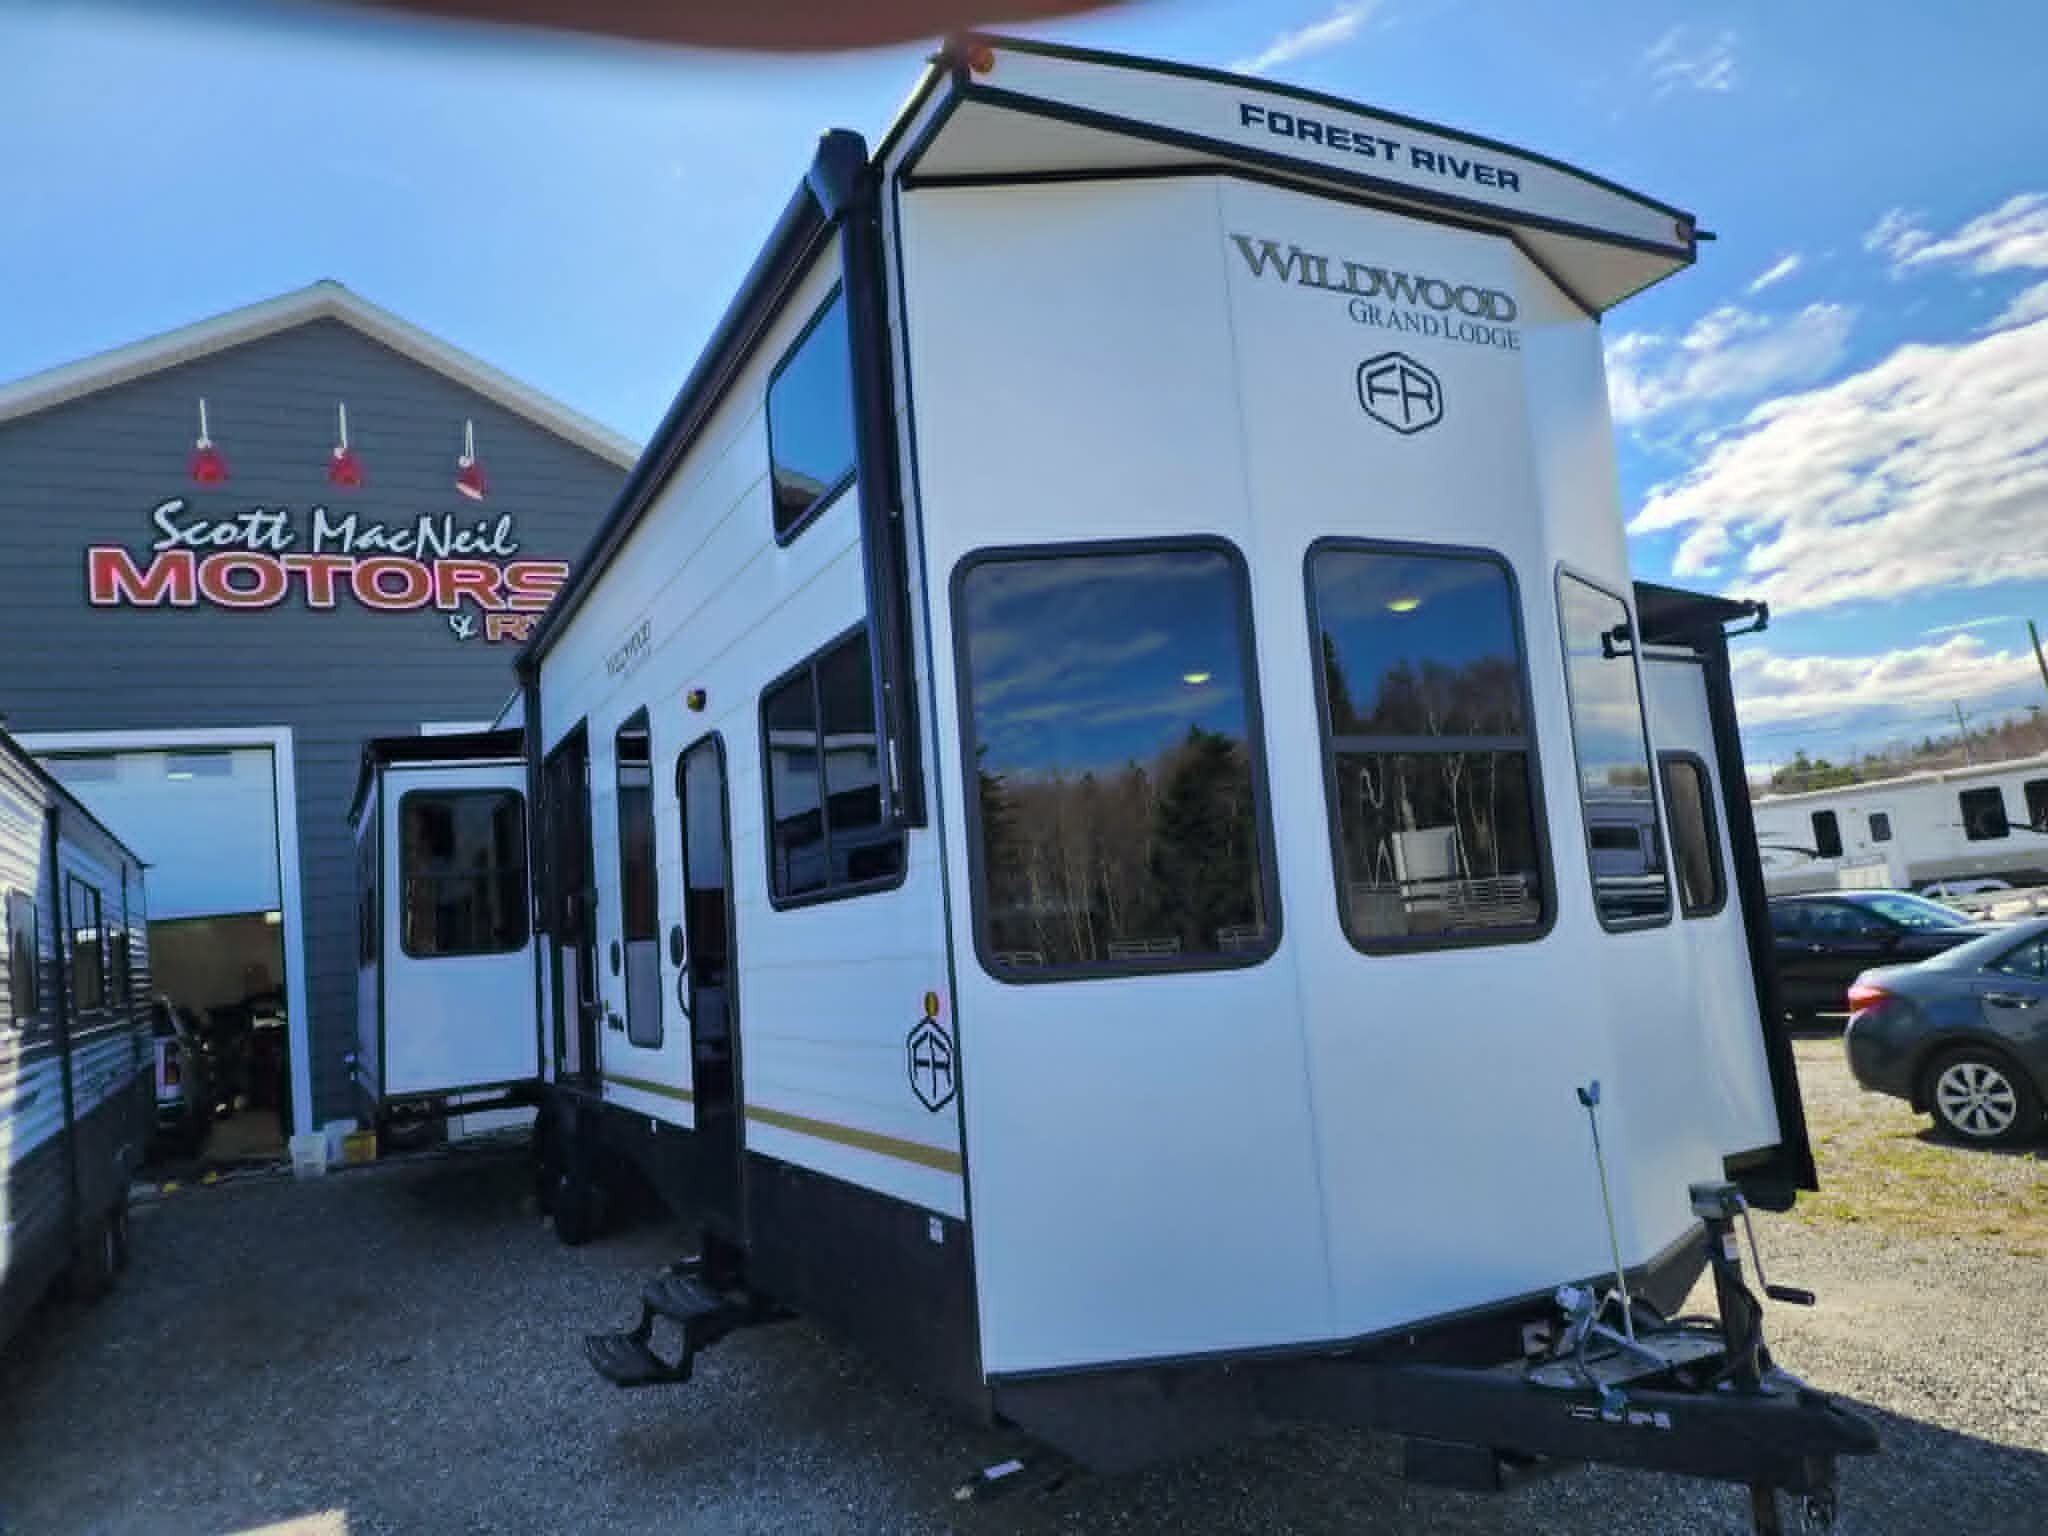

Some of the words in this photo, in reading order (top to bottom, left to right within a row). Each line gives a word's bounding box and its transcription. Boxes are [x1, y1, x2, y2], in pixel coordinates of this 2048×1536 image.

[1239, 103, 1400, 161] FOREST
[1411, 146, 1520, 192] RIVER
[1229, 233, 1517, 323] WILDWOOD
[1349, 299, 1439, 338] GRAND
[1443, 318, 1521, 351] LODGE
[153, 499, 296, 550] Scott
[313, 507, 520, 559] MacNeil
[87, 547, 570, 611] MOTORS
[449, 614, 480, 641] &
